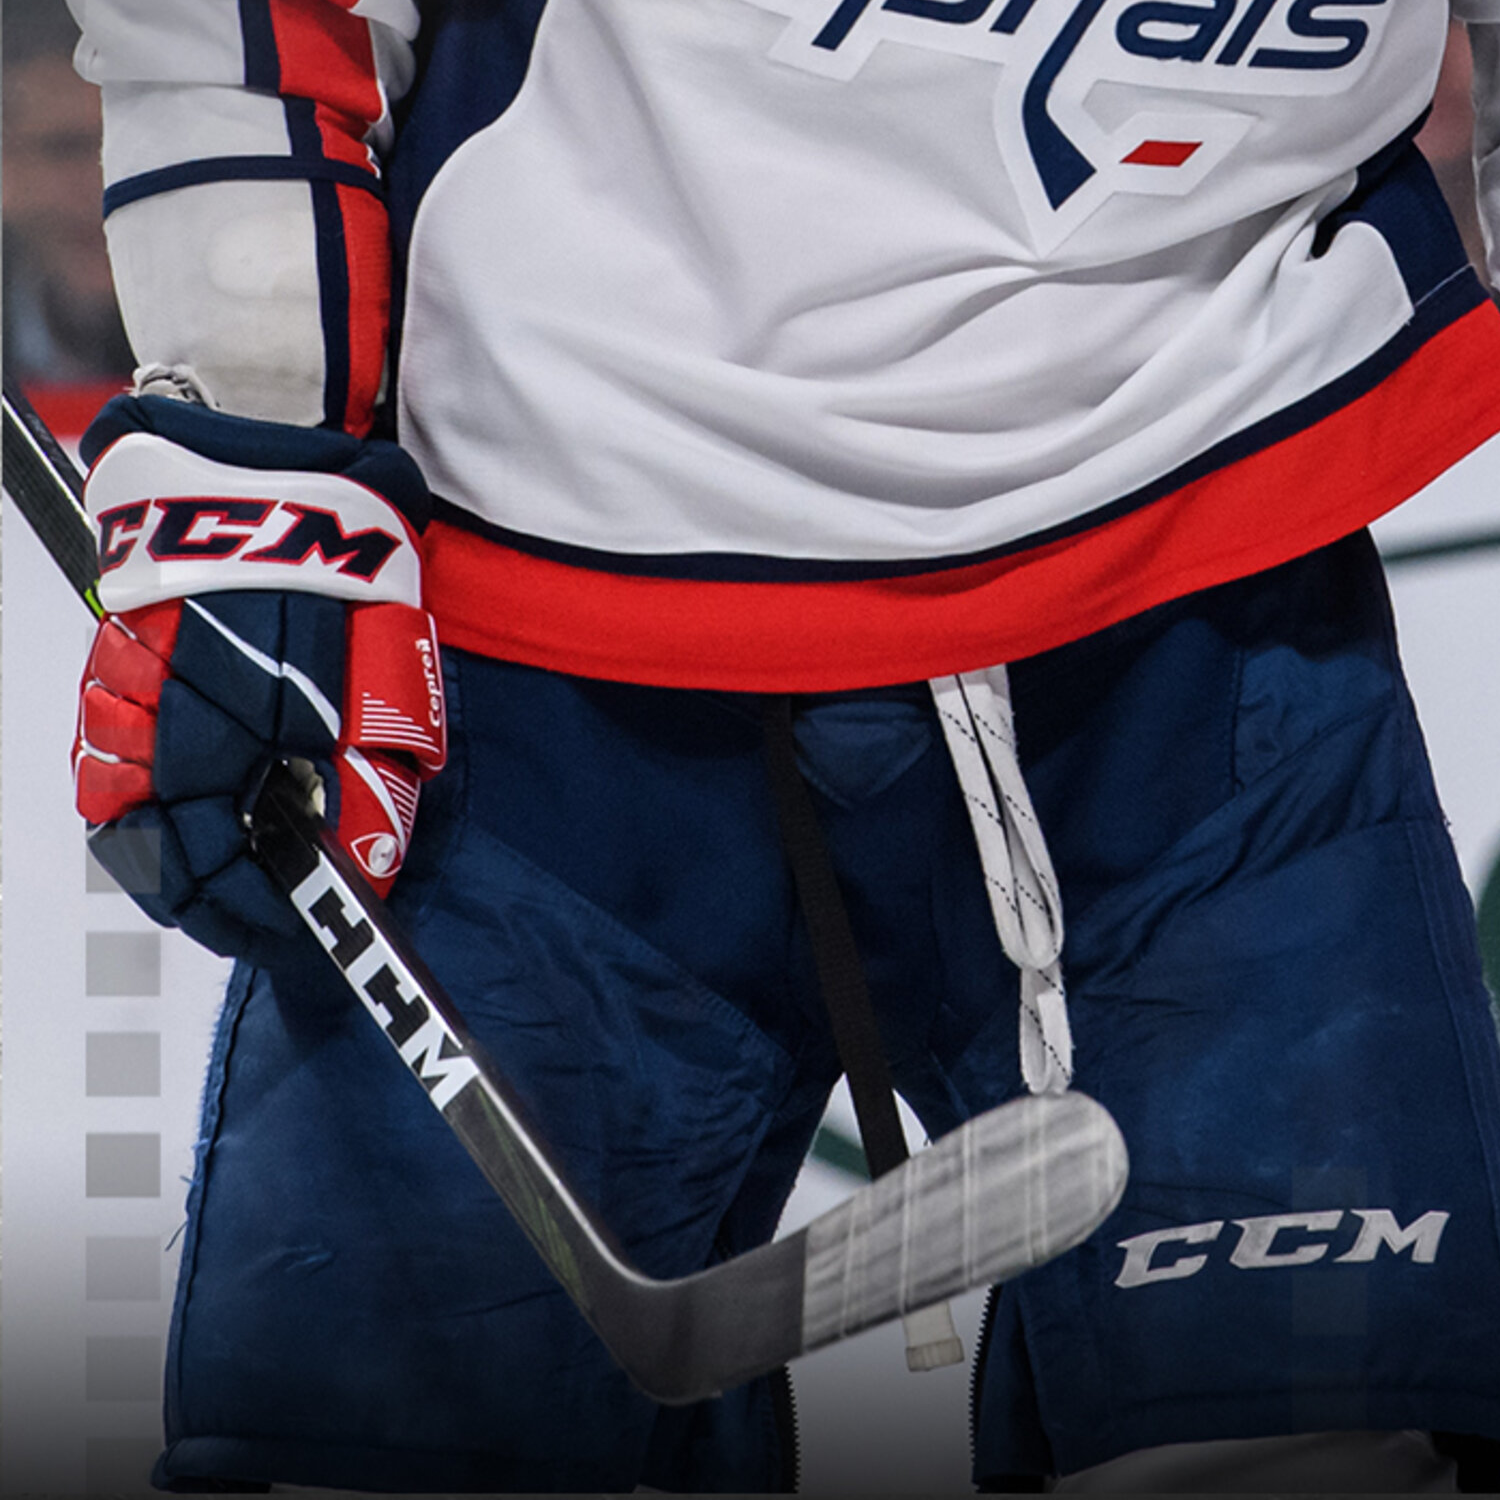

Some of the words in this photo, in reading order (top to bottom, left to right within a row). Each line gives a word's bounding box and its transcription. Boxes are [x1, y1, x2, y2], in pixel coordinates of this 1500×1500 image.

[97, 496, 402, 584] CCM
[290, 850, 480, 1112] CCM
[1114, 1208, 1450, 1289] CCM
